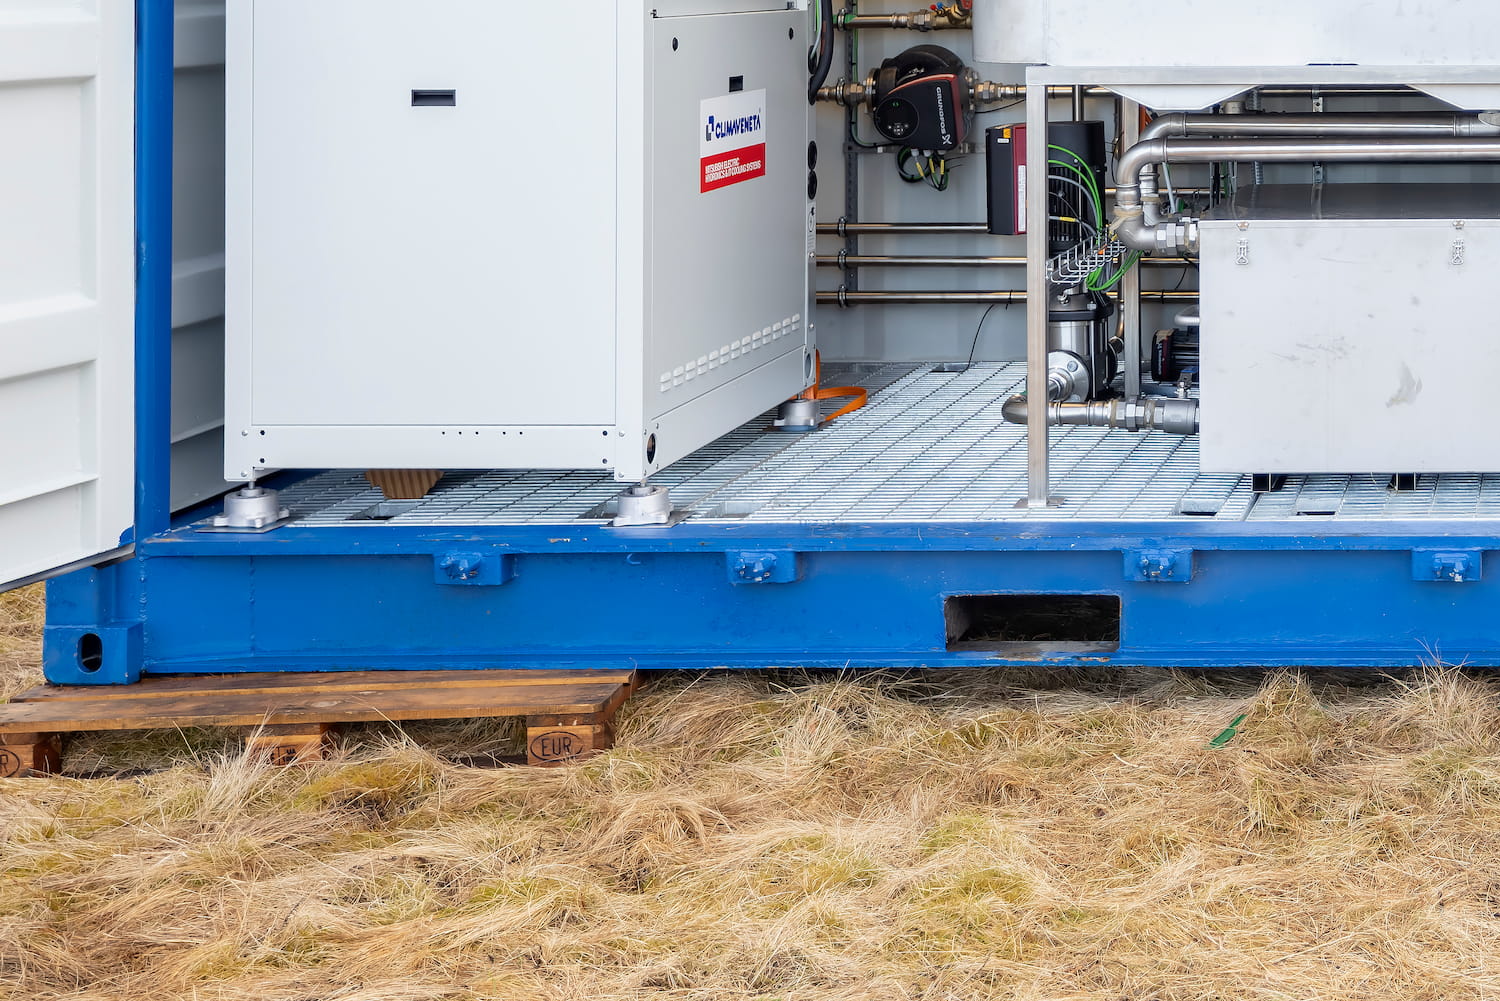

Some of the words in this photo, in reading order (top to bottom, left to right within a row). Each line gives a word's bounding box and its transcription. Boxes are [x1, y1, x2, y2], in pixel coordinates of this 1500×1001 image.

[936, 86, 946, 134] GRUNDFOS
[715, 114, 761, 139] CLIMAVENETA
[541, 737, 572, 756] EUR
